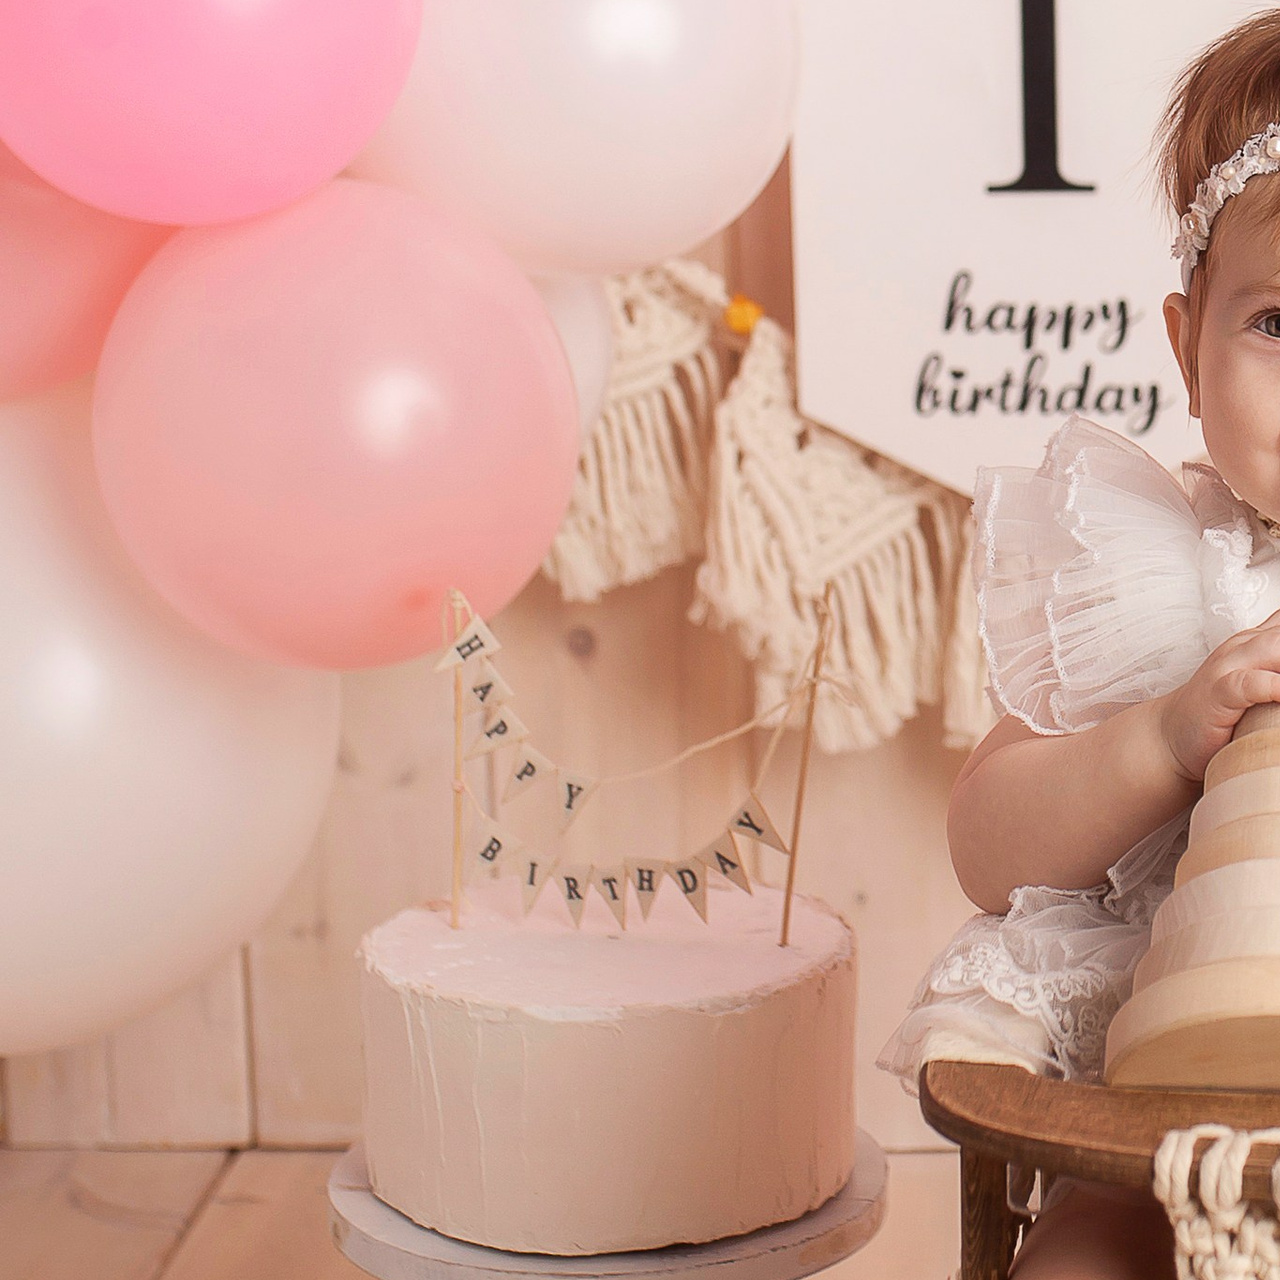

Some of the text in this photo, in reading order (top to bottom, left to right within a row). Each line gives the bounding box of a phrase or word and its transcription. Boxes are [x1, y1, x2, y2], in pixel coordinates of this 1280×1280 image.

[943, 270, 1138, 353] happy
[913, 352, 1168, 434] birthday
[455, 634, 583, 810] HAPPY
[480, 812, 765, 902] BIRTHDAY
